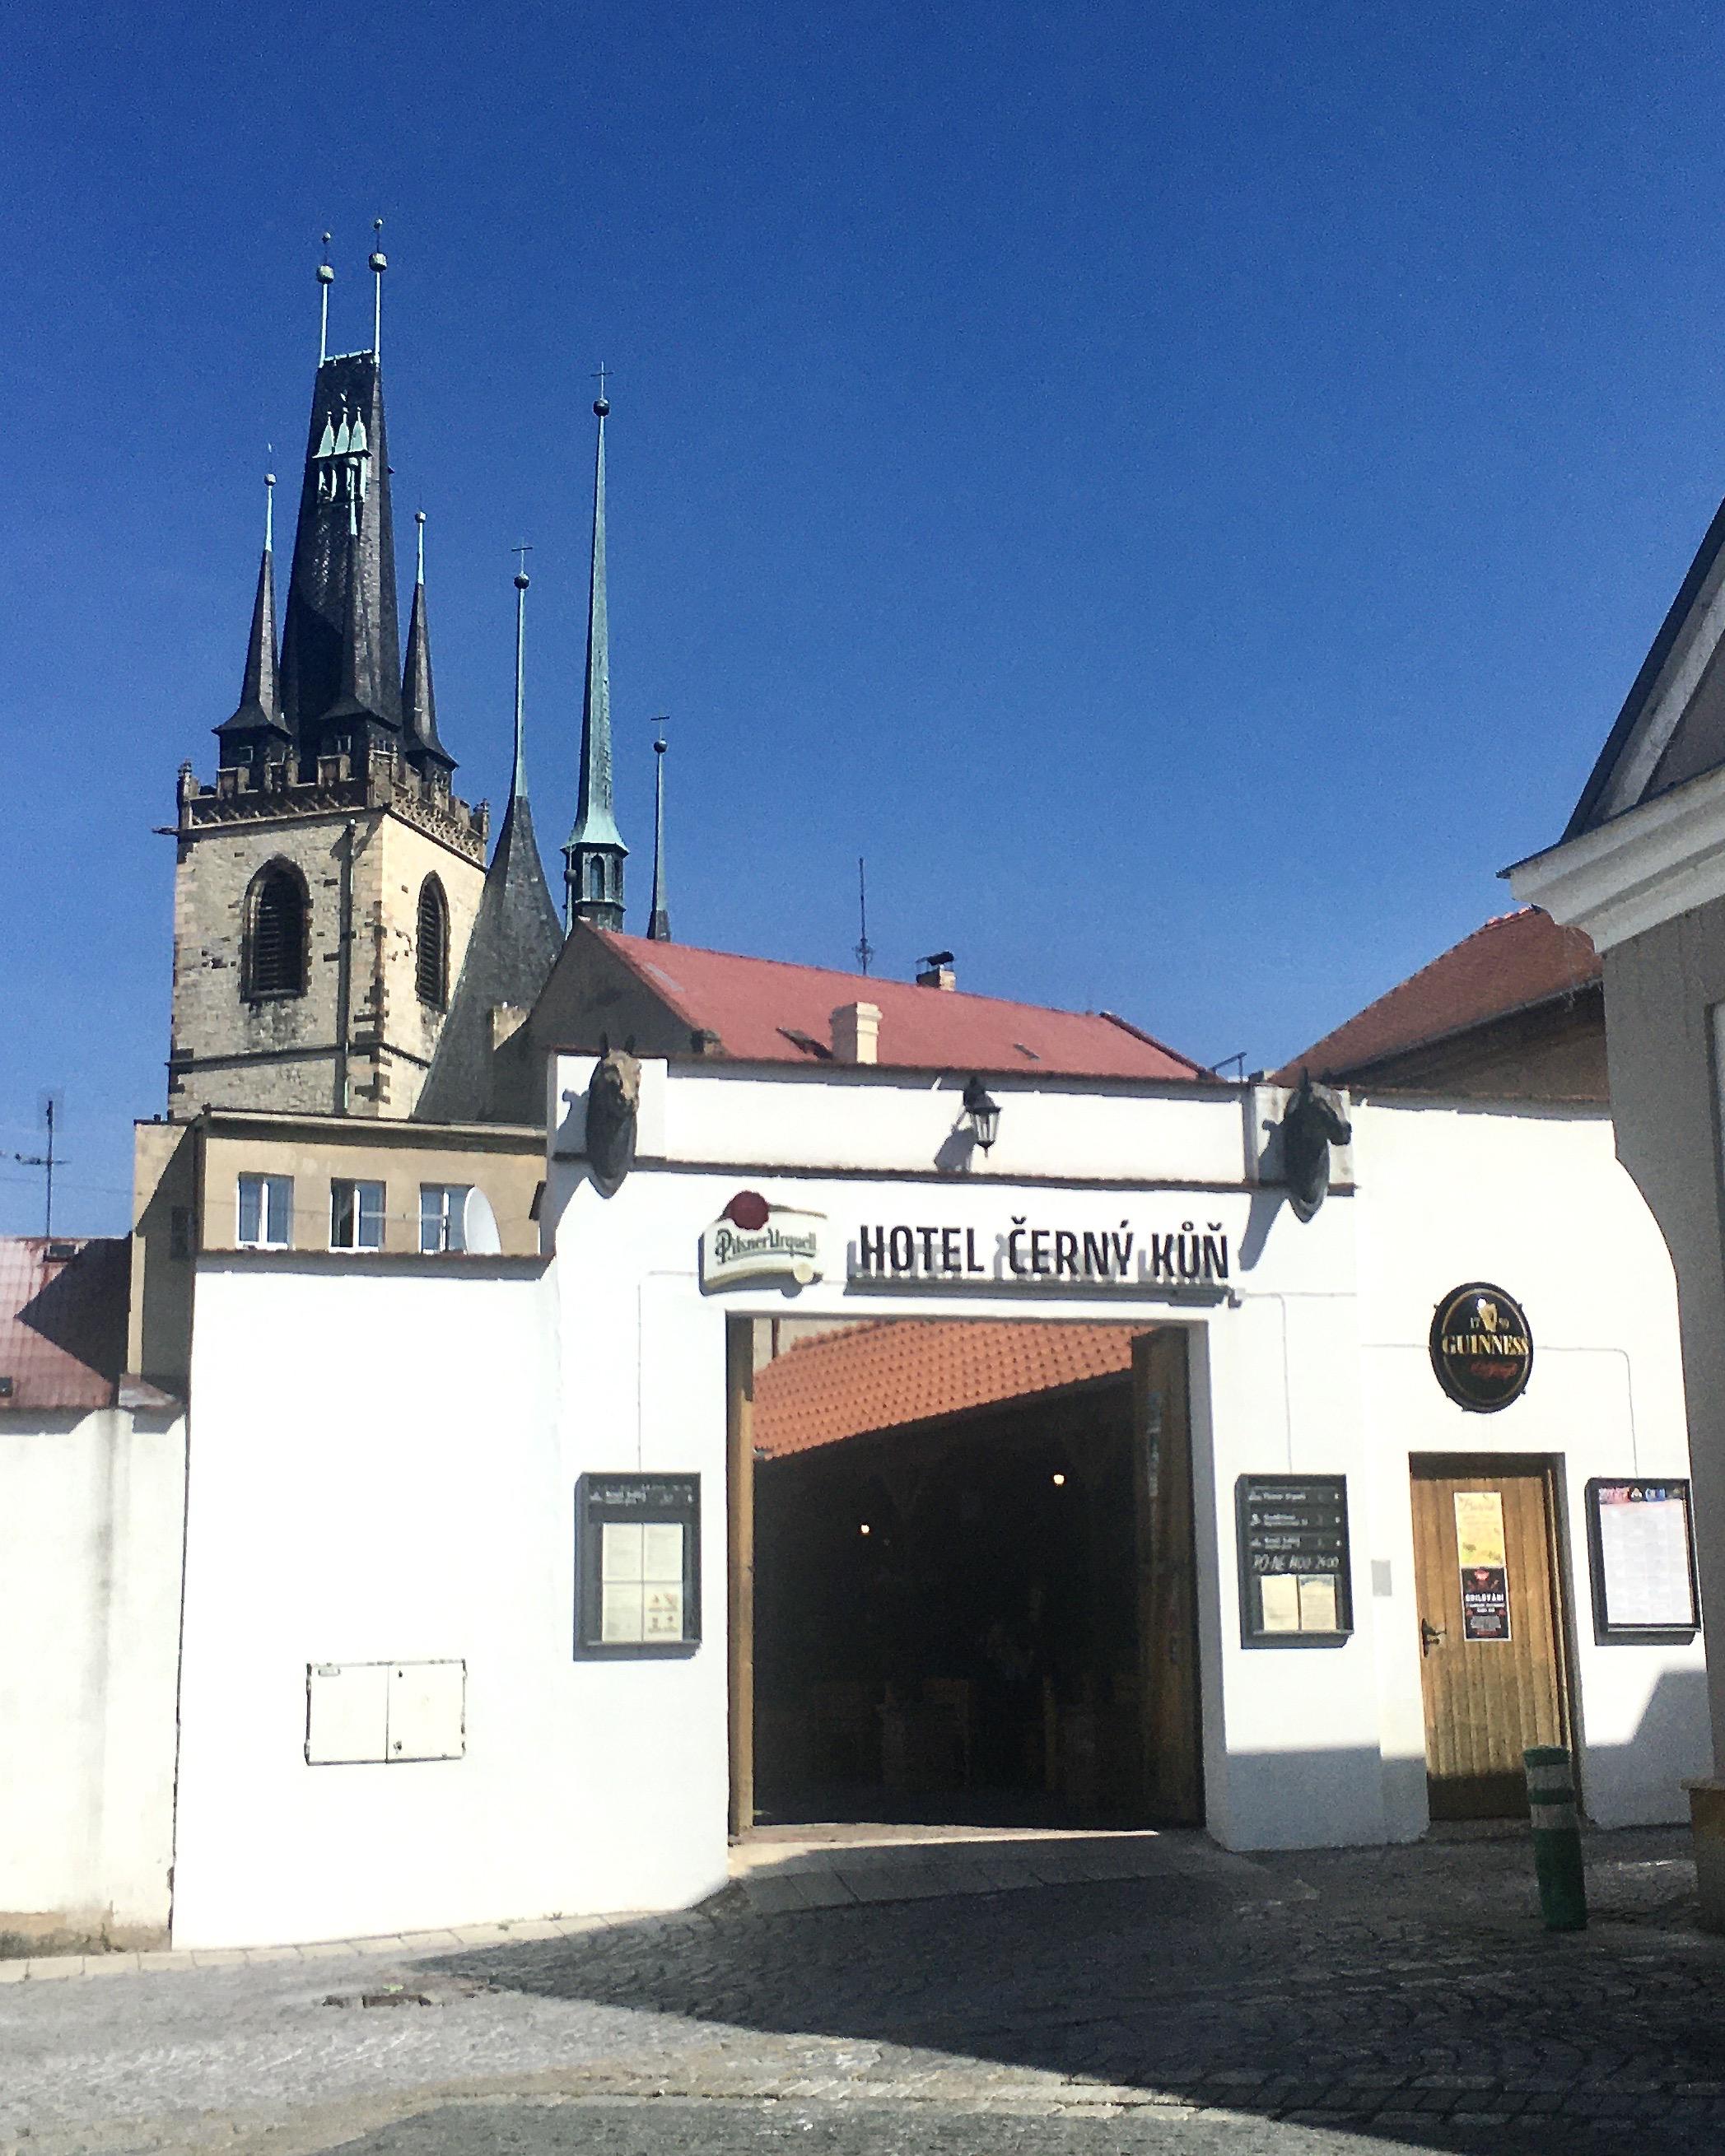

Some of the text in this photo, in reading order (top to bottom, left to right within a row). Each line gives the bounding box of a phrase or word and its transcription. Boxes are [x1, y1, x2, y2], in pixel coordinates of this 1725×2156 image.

[715, 1227, 817, 1264] Pilsner Urquell
[860, 1215, 1228, 1278] HOTEL ČERNÝ KŮŇ
[1442, 1334, 1529, 1355] GUINNESS
